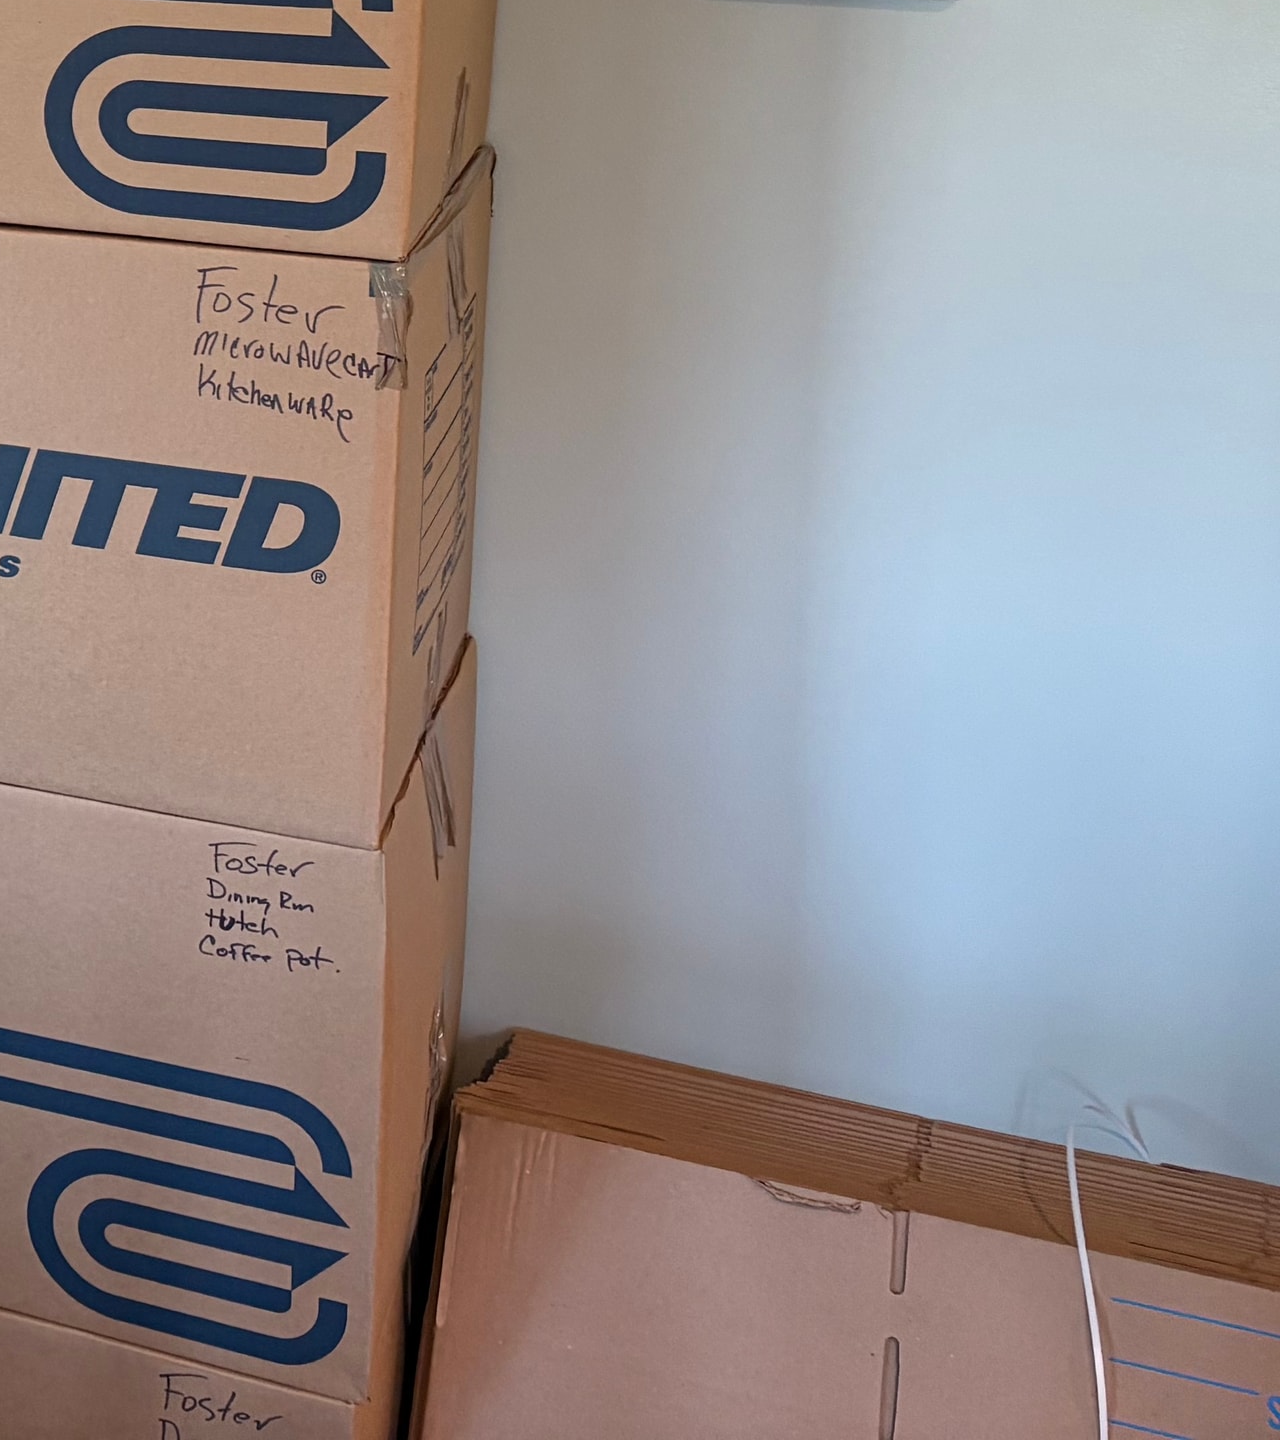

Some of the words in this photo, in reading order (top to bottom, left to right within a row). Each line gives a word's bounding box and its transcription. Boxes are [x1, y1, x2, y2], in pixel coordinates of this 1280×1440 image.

[196, 265, 346, 334] Foster
[208, 841, 316, 878] Foster
[159, 1373, 284, 1432] Foster
